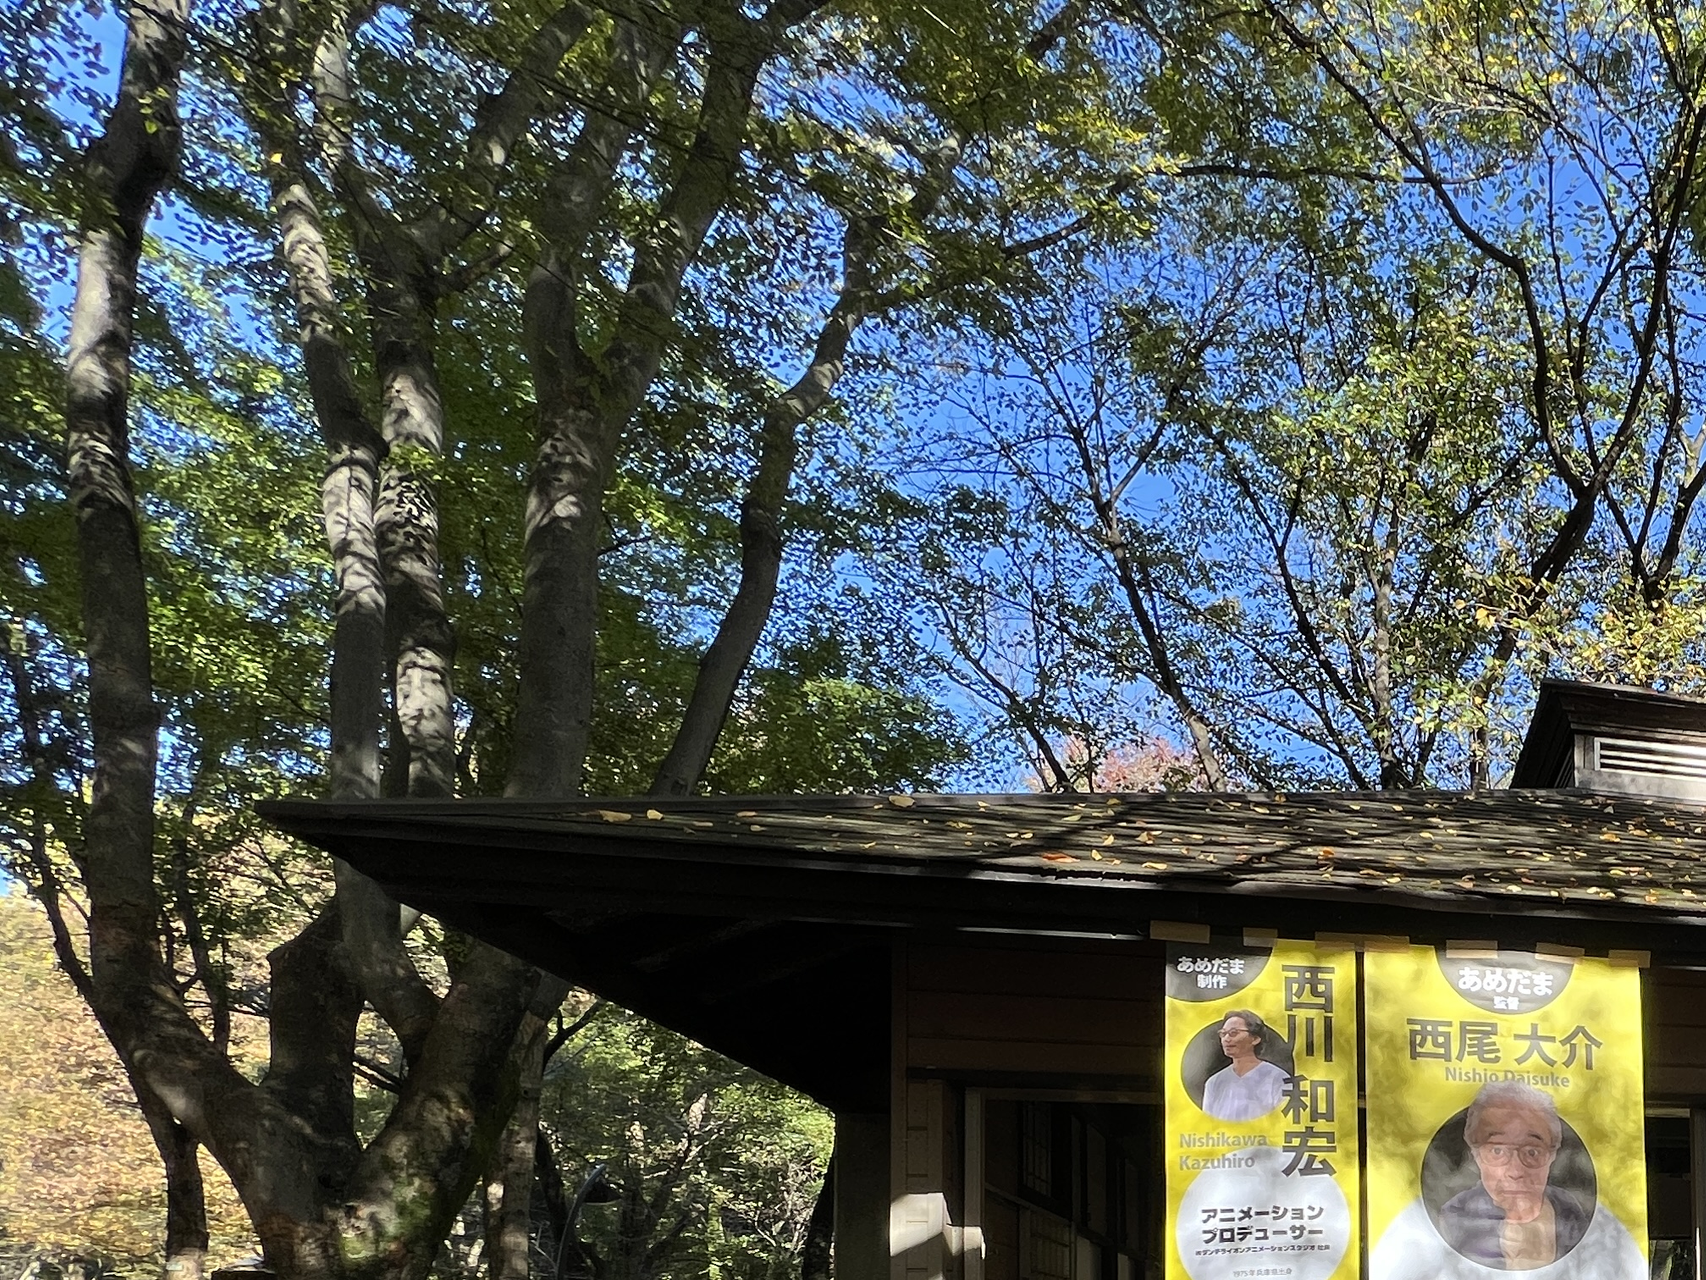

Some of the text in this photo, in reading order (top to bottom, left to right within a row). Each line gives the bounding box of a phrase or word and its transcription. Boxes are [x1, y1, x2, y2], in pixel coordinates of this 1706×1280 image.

[1177, 956, 1245, 975] あめだま
[1197, 974, 1227, 989] 制作
[1458, 966, 1554, 996] あめだま
[1493, 996, 1520, 1010] 監督
[1406, 1018, 1603, 1070] 西尾 大介
[1445, 1066, 1499, 1083] Nishio
[1179, 1132, 1267, 1149] Nishikawa
[1179, 1154, 1256, 1171] Kazuhiro
[1201, 1205, 1324, 1223] アニメーション
[1202, 1225, 1324, 1244] プロデューサー
